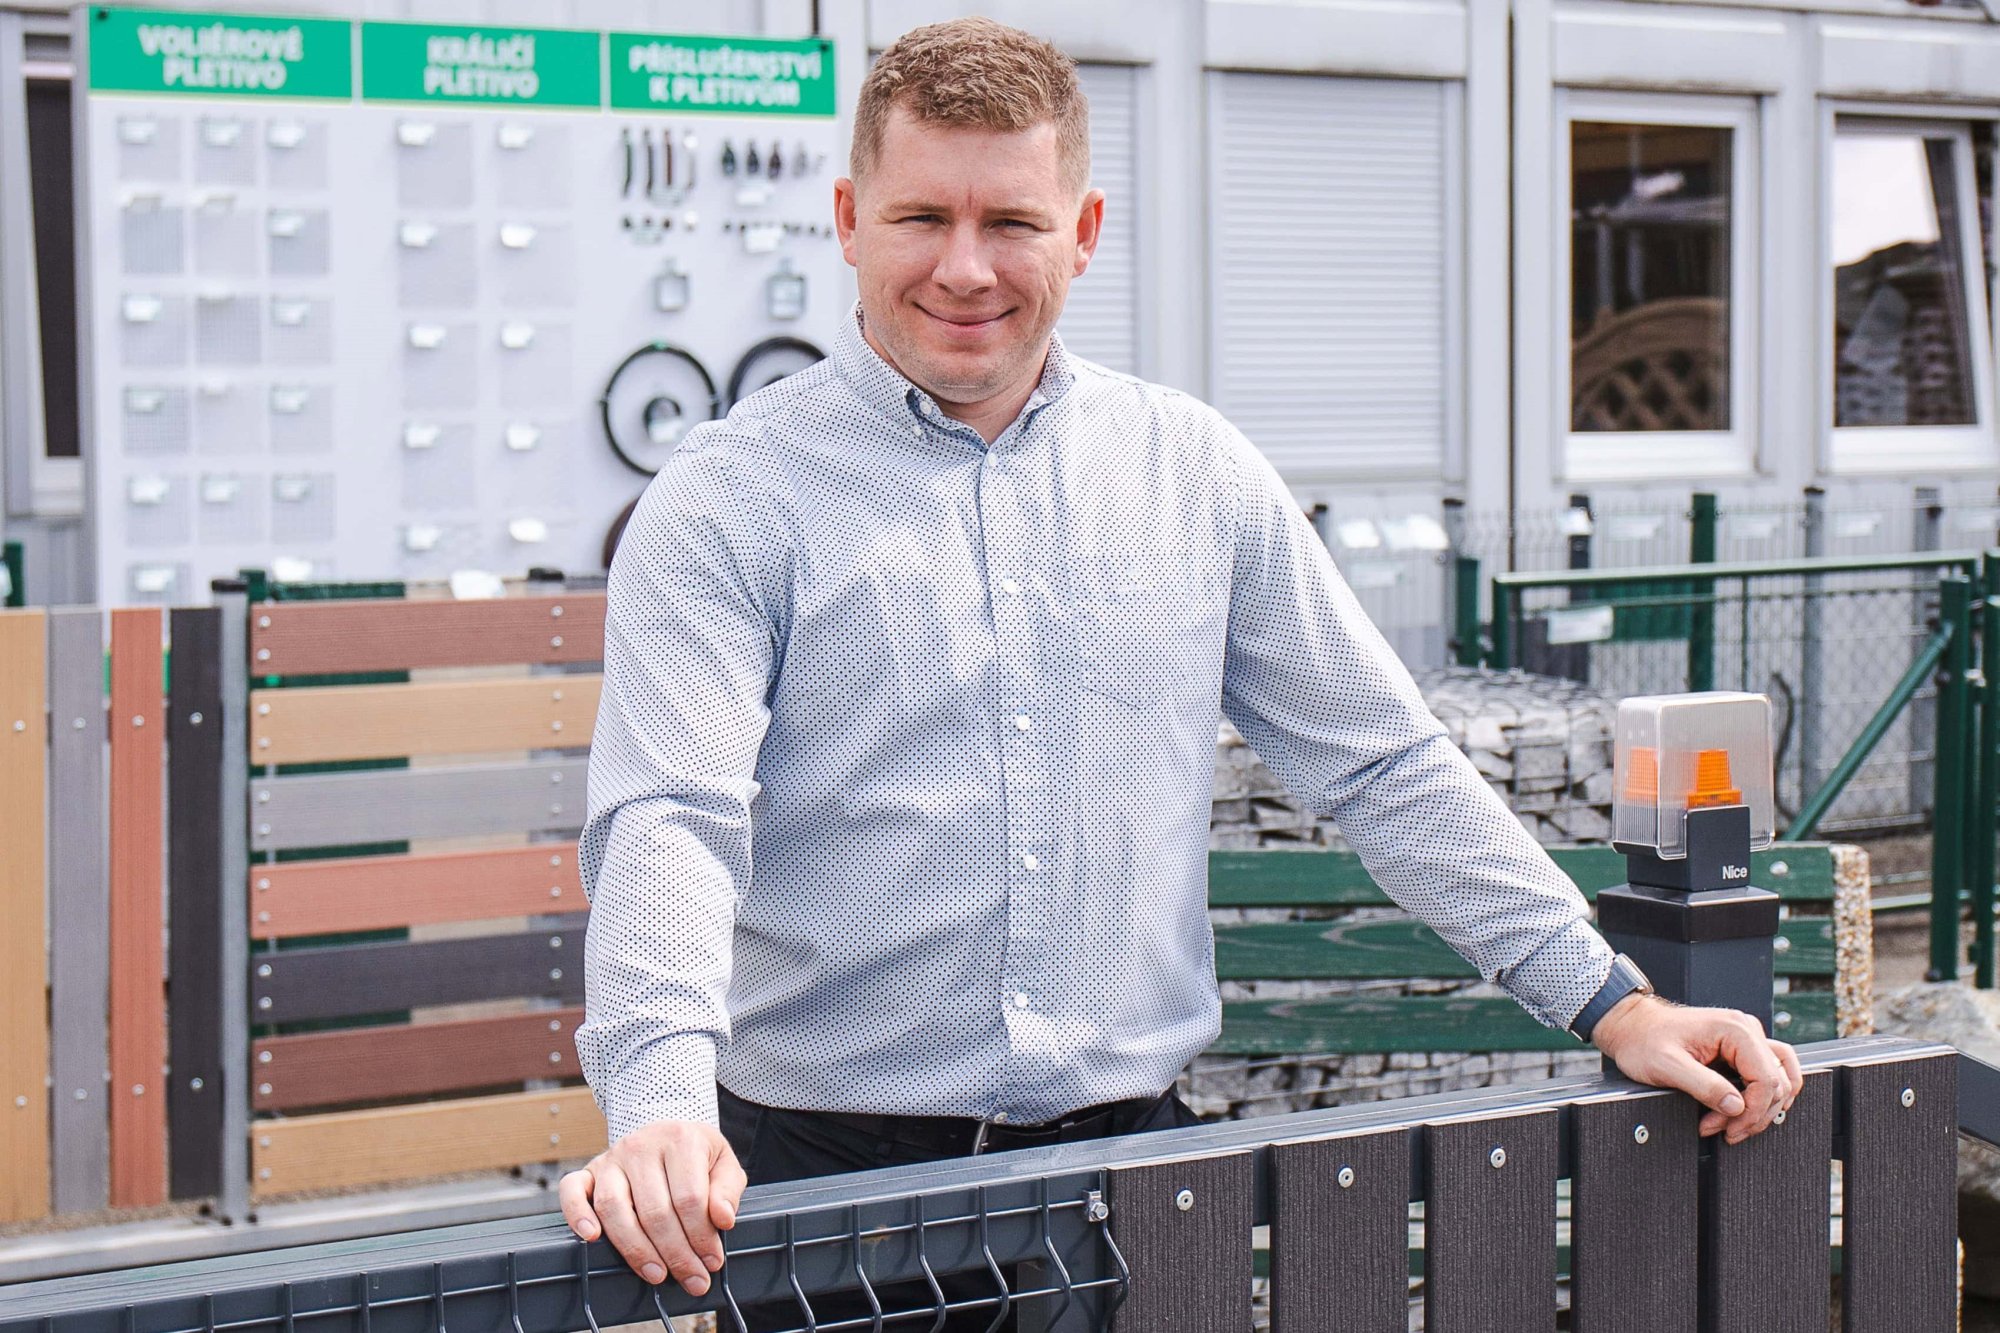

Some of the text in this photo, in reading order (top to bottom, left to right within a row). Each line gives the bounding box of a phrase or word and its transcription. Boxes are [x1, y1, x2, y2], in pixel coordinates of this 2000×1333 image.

[138, 23, 302, 60] VOLIÉROVÉ
[428, 33, 534, 67] KRÁLIČÍ
[163, 58, 286, 89] PLETIVO
[629, 43, 821, 79] PŘÍSLUŠENSTVÍ
[424, 66, 538, 97] PLETIVO
[649, 77, 669, 101] K
[1722, 865, 1747, 879] Nice
